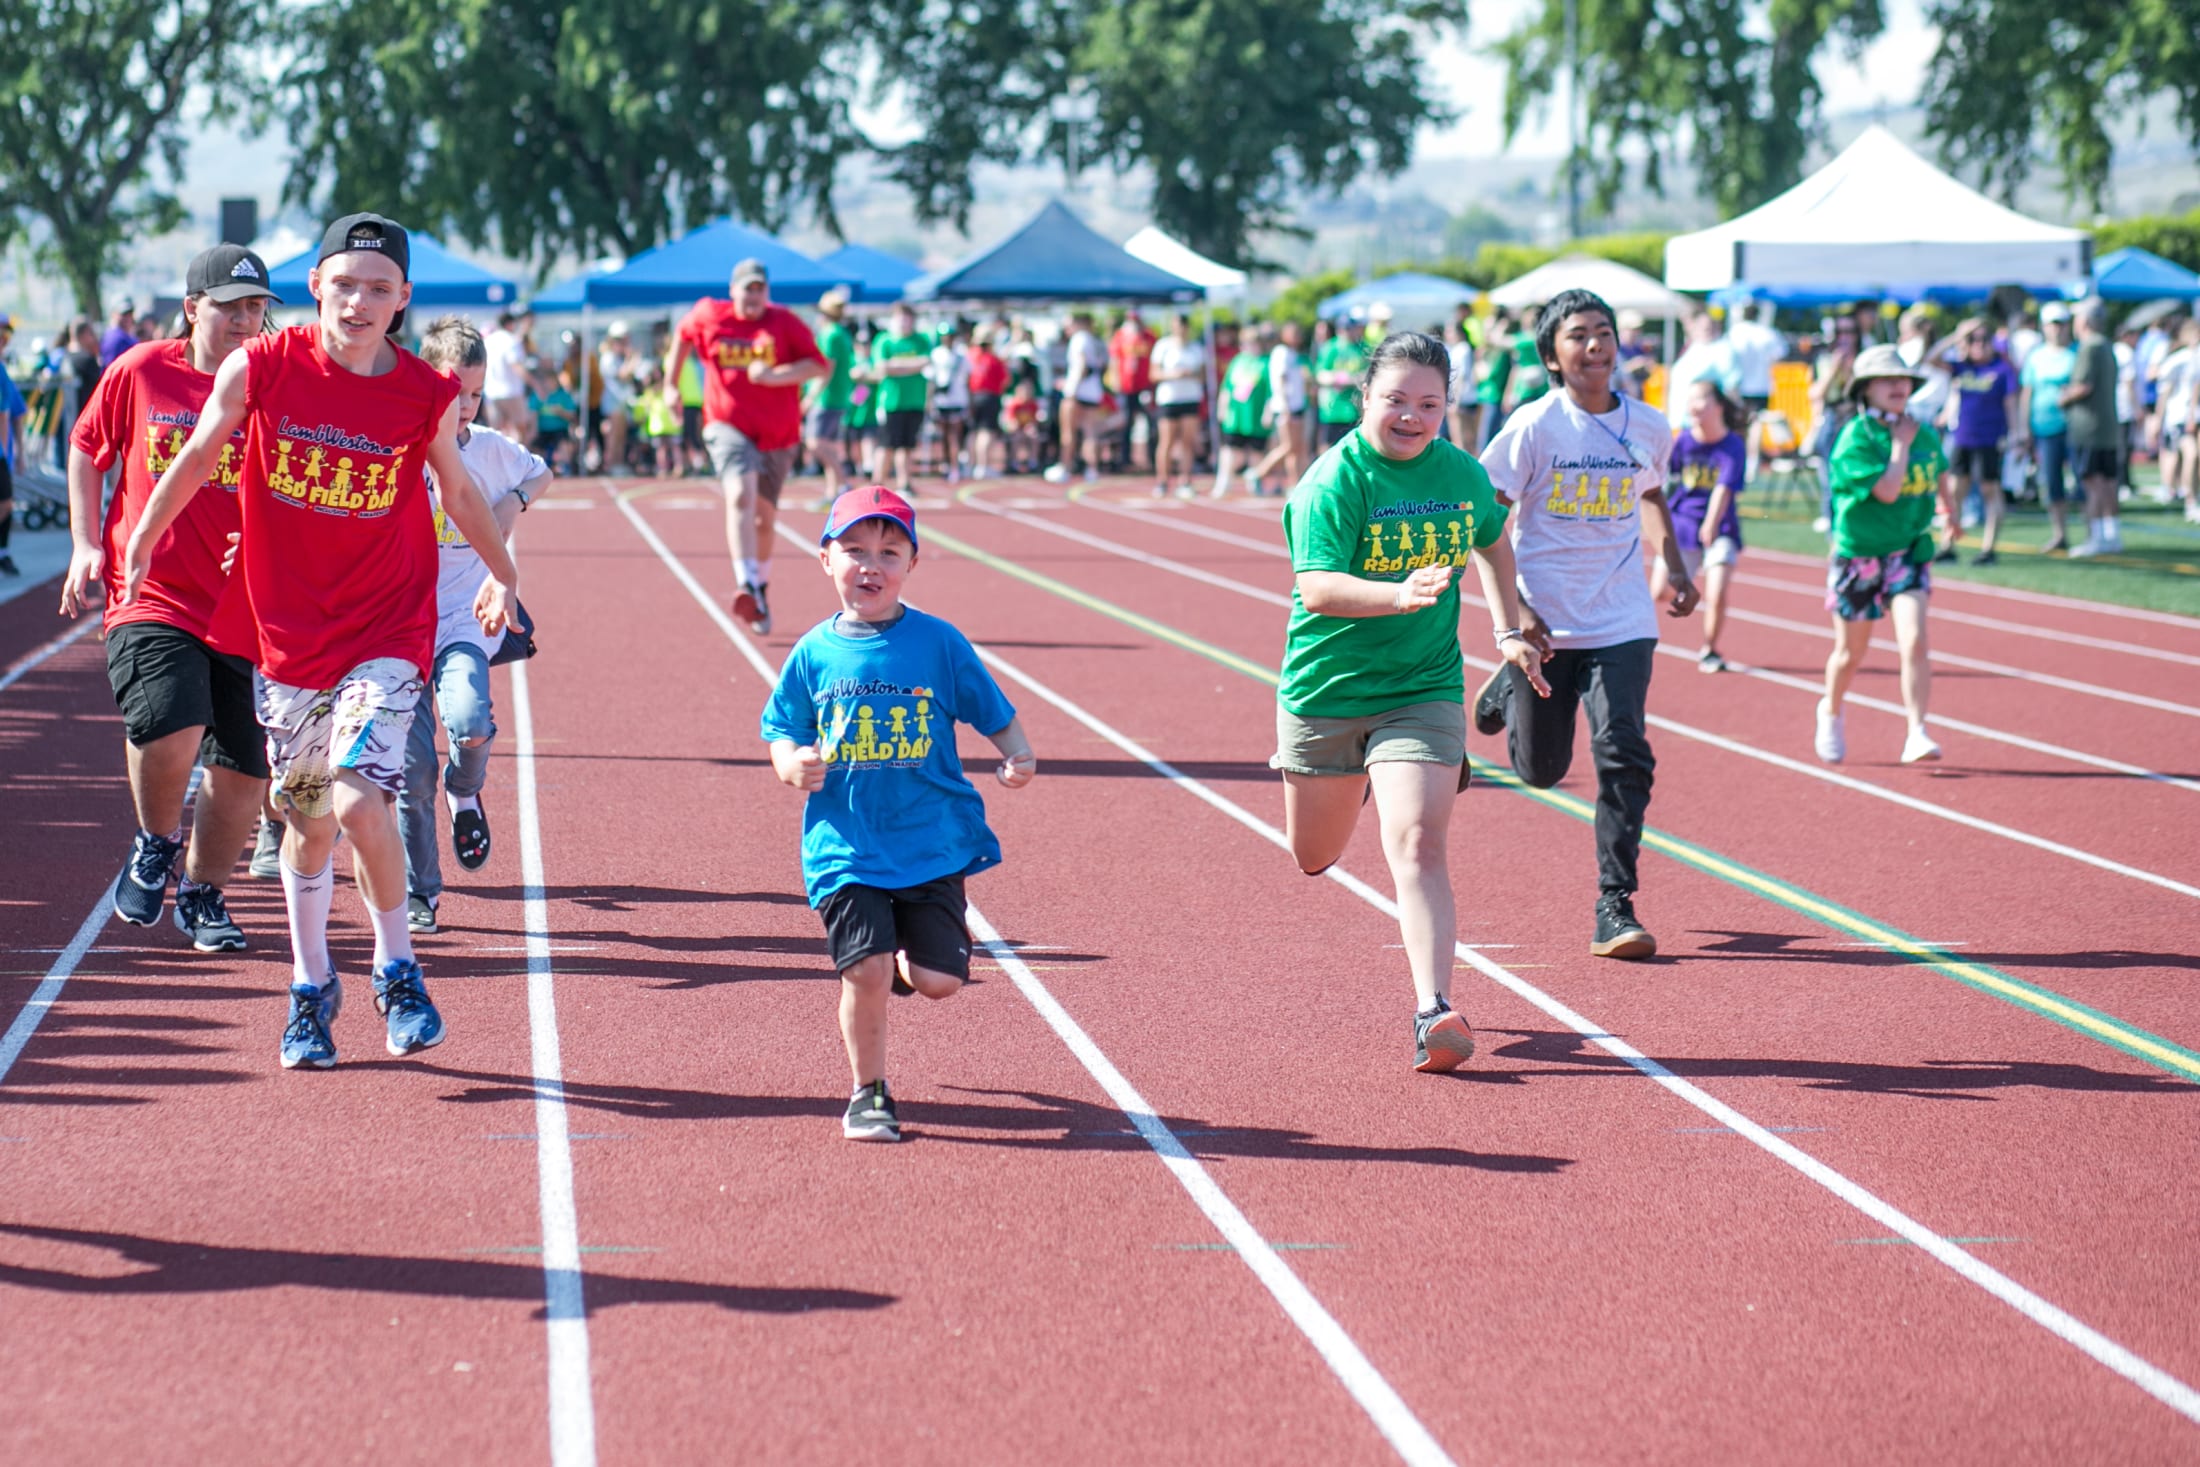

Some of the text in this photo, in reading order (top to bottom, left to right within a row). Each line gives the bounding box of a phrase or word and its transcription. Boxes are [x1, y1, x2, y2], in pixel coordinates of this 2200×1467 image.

[221, 470, 241, 485] DA
[268, 473, 398, 510] RSD FIELD DAY
[1369, 499, 1452, 520] ambWeston
[1581, 501, 1619, 517] FIELD
[1363, 557, 1403, 572] RSD
[840, 741, 893, 762] FIELD
[897, 737, 933, 759] DAY
